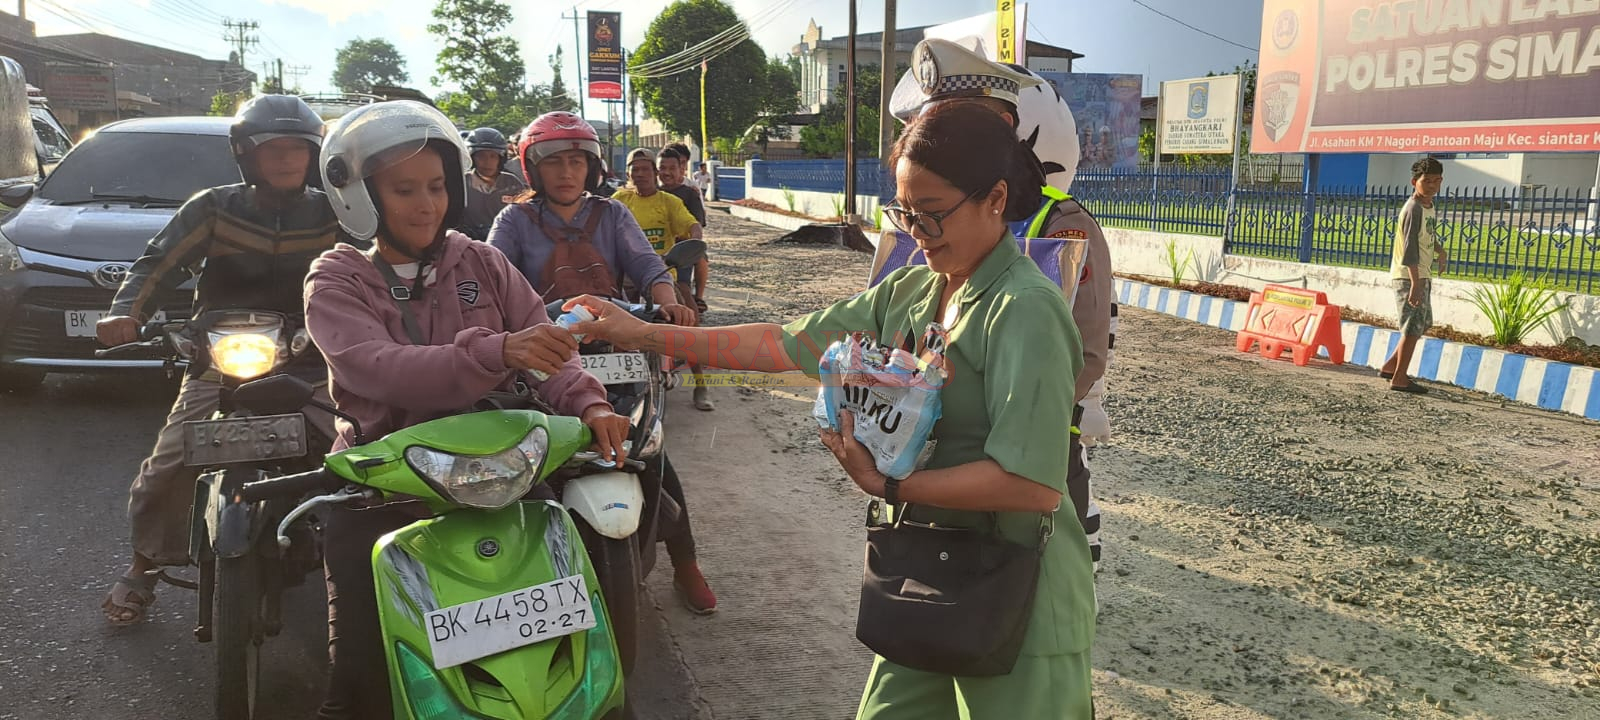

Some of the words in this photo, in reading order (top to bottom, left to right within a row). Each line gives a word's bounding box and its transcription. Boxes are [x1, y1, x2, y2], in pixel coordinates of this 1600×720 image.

[1326, 42, 1479, 93] POLRES
[1170, 124, 1222, 133] BHAYANGKARI
[1321, 136, 1356, 147] Asahan
[1358, 136, 1374, 146] KM
[1376, 136, 1382, 146] 7
[1384, 134, 1420, 149] Nagori
[1422, 133, 1470, 146] Pantoan
[1473, 132, 1504, 148] Maju
[1507, 132, 1535, 145] Kec.
[1538, 131, 1590, 145] siantar
[70, 313, 88, 327] BK
[615, 355, 643, 367] TBS
[431, 607, 468, 642] BK
